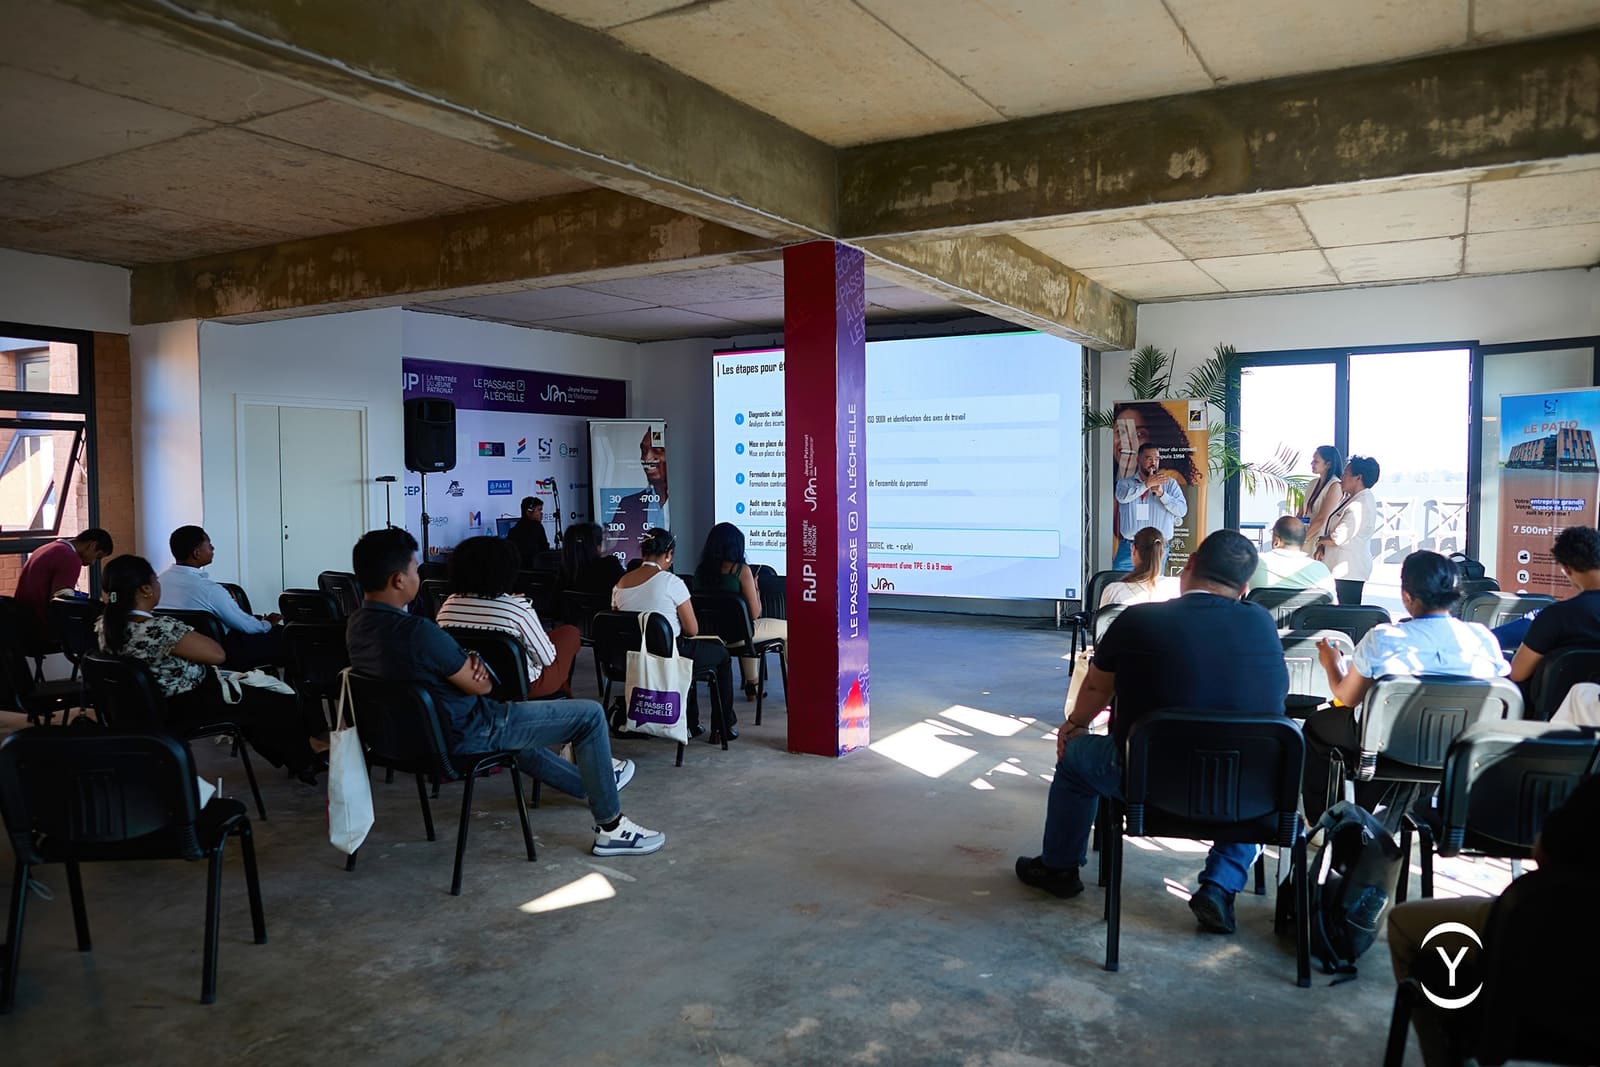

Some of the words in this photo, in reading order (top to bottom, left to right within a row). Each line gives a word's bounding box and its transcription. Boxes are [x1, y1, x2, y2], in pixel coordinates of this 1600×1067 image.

[722, 363, 734, 375] Les
[735, 364, 759, 375] étapes
[760, 363, 777, 375] pour
[473, 379, 482, 387] LE
[483, 380, 515, 391] PASSAGE
[887, 415, 893, 423] et
[893, 413, 921, 423] identification
[922, 413, 932, 422] des
[944, 413, 951, 421] de
[951, 412, 966, 421] travail
[1523, 424, 1537, 434] LE
[1541, 419, 1579, 432] PATIO
[765, 440, 777, 448] place
[847, 402, 857, 488] L'ÉCHELLE
[906, 480, 929, 488] personnel
[609, 495, 621, 503] 30
[608, 522, 626, 532] 100
[913, 561, 923, 570] TPE
[849, 537, 858, 615] PASSAGE
[803, 564, 817, 602] RJP
[850, 617, 859, 638] LE
[644, 701, 665, 710] PASSE
